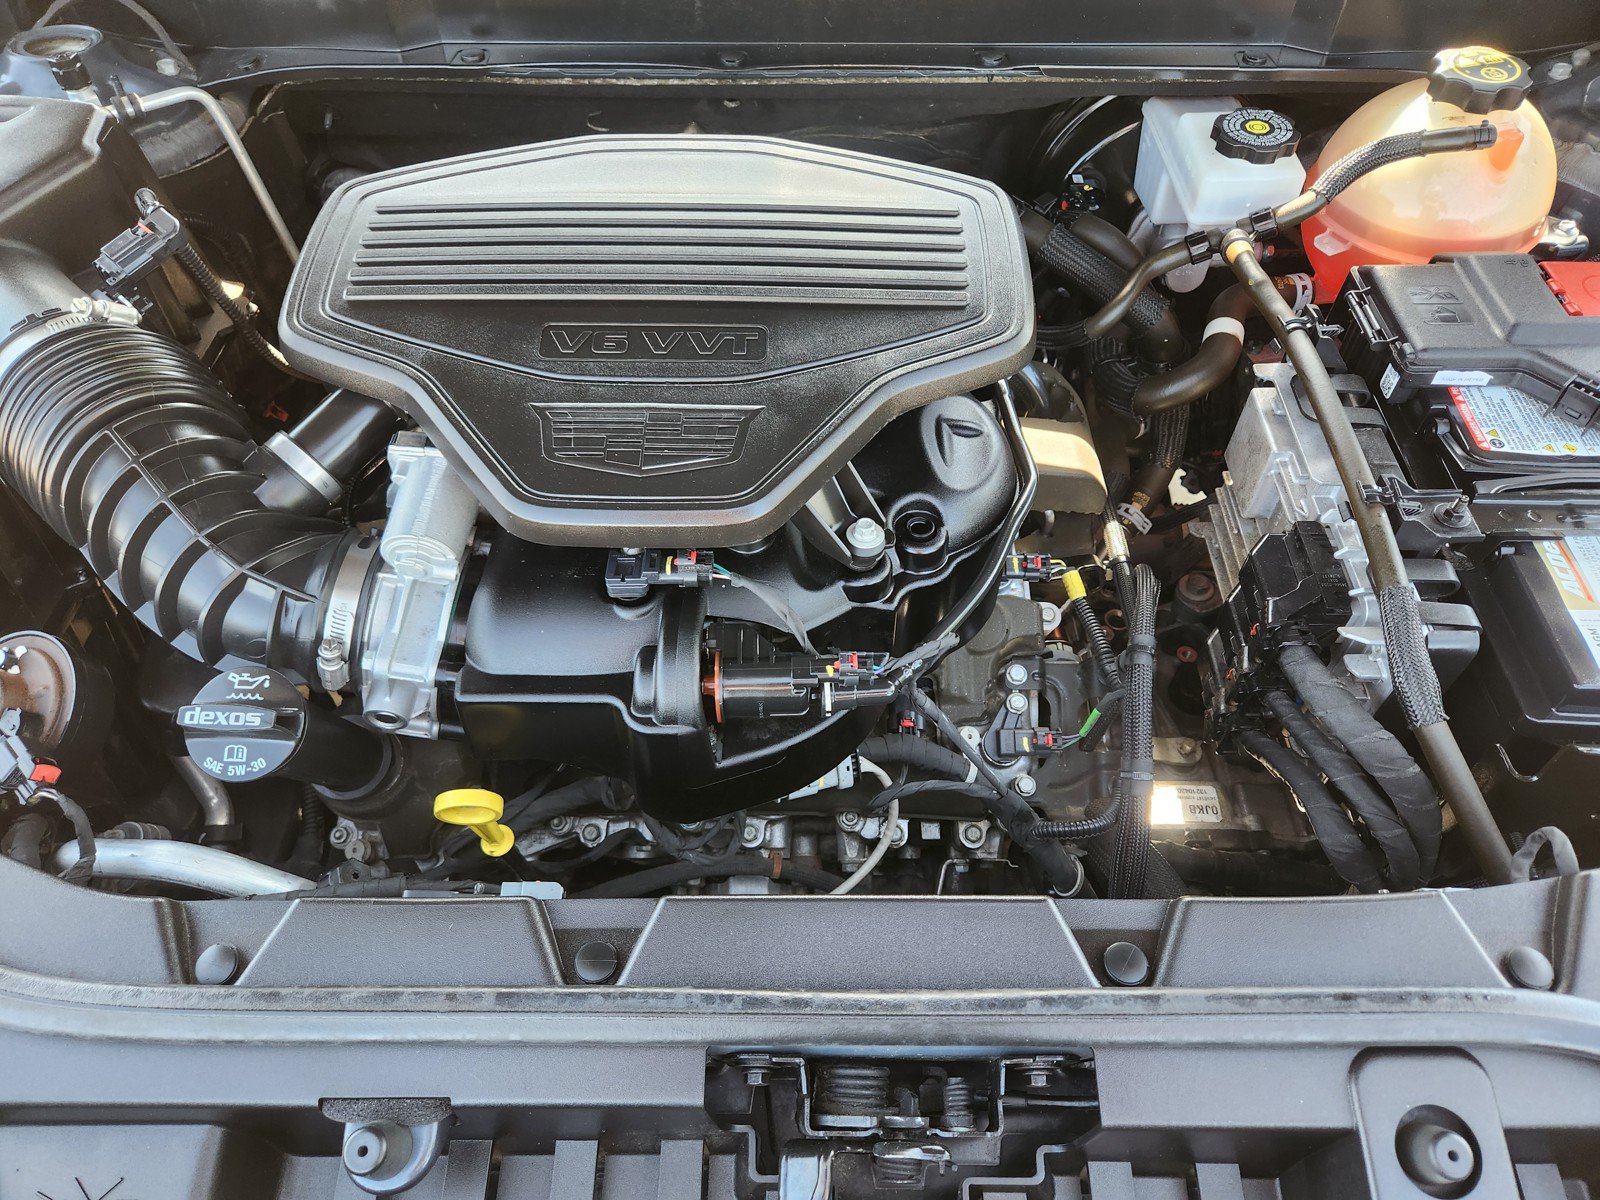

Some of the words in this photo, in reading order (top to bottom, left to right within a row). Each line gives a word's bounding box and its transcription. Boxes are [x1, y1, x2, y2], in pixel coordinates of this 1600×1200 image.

[549, 330, 629, 353] V6
[641, 331, 759, 354] VVT
[1542, 540, 1586, 600] ACDe
[185, 707, 261, 726] dexos
[203, 757, 224, 774] SAE
[227, 757, 267, 776] 5W-30
